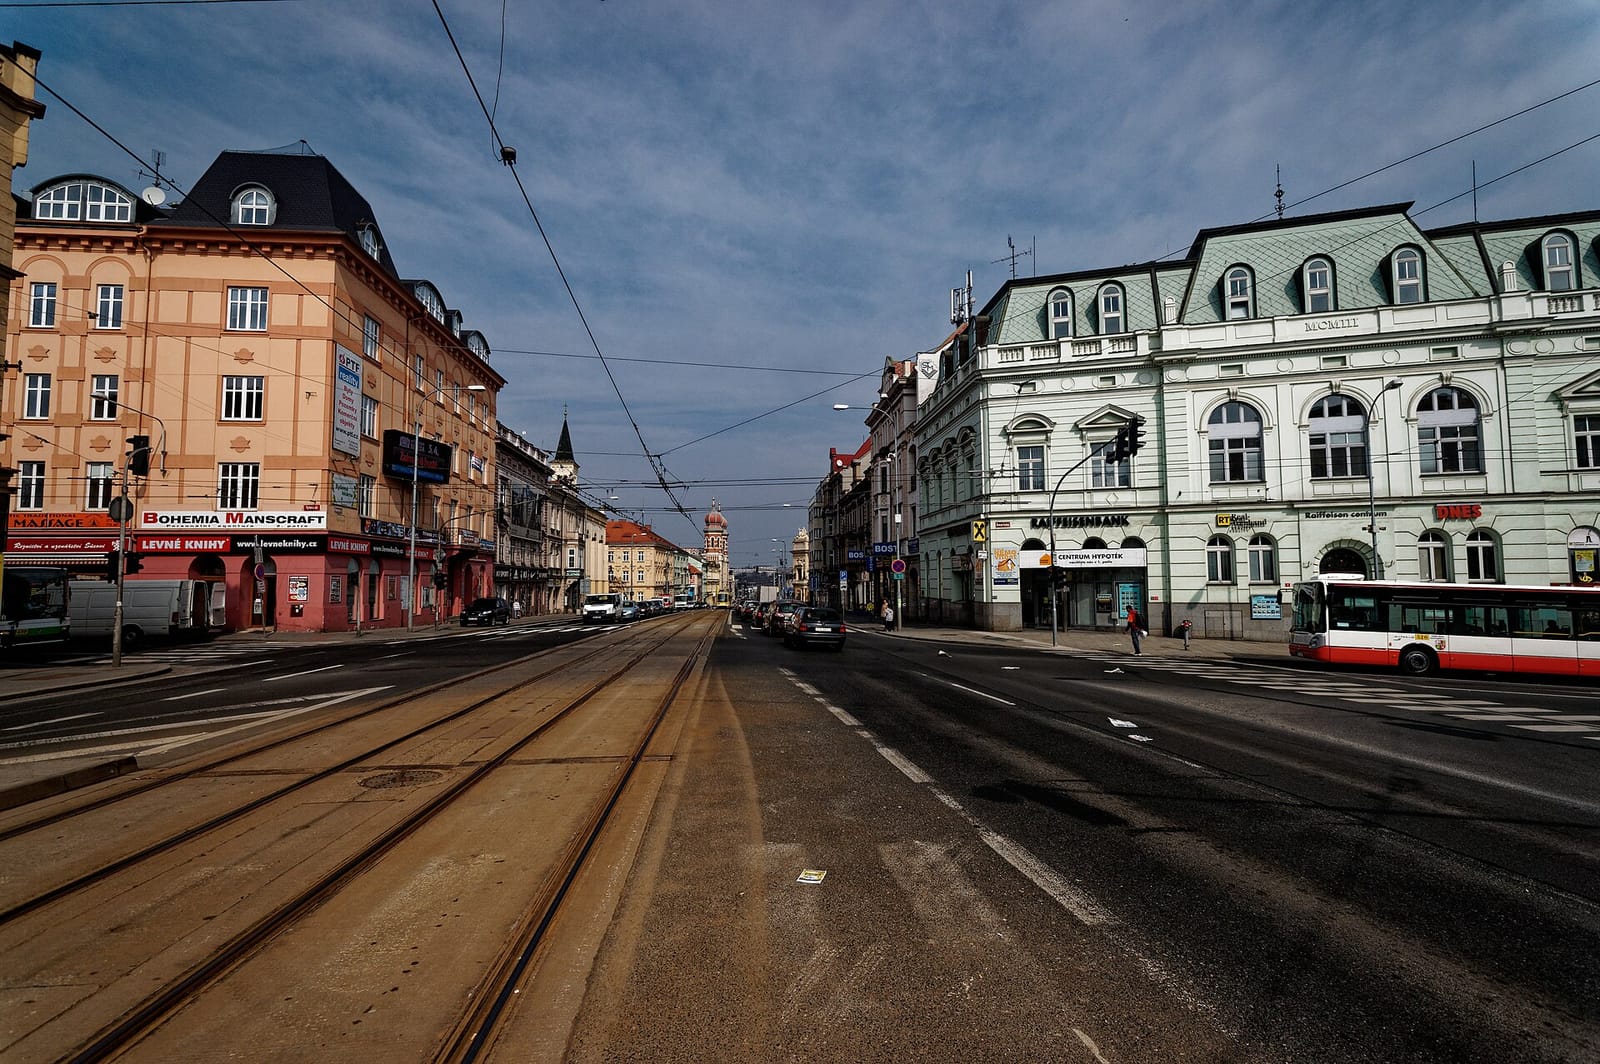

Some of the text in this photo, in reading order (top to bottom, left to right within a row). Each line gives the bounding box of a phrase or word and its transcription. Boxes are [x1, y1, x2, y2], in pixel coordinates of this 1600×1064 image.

[346, 357, 361, 373] PTF
[339, 371, 359, 389] reality
[143, 512, 325, 525] BOHEMIA MANSCRAFT
[1305, 511, 1349, 519] Raiffeisen
[1436, 505, 1482, 521] DNES
[14, 519, 84, 528] MASSAGE
[1218, 516, 1229, 524] RT
[142, 538, 225, 550] LEVNÉ KNIHY
[330, 540, 369, 552] LEVNÉ KNIHY
[1092, 552, 1123, 560] HYPOTÉK
